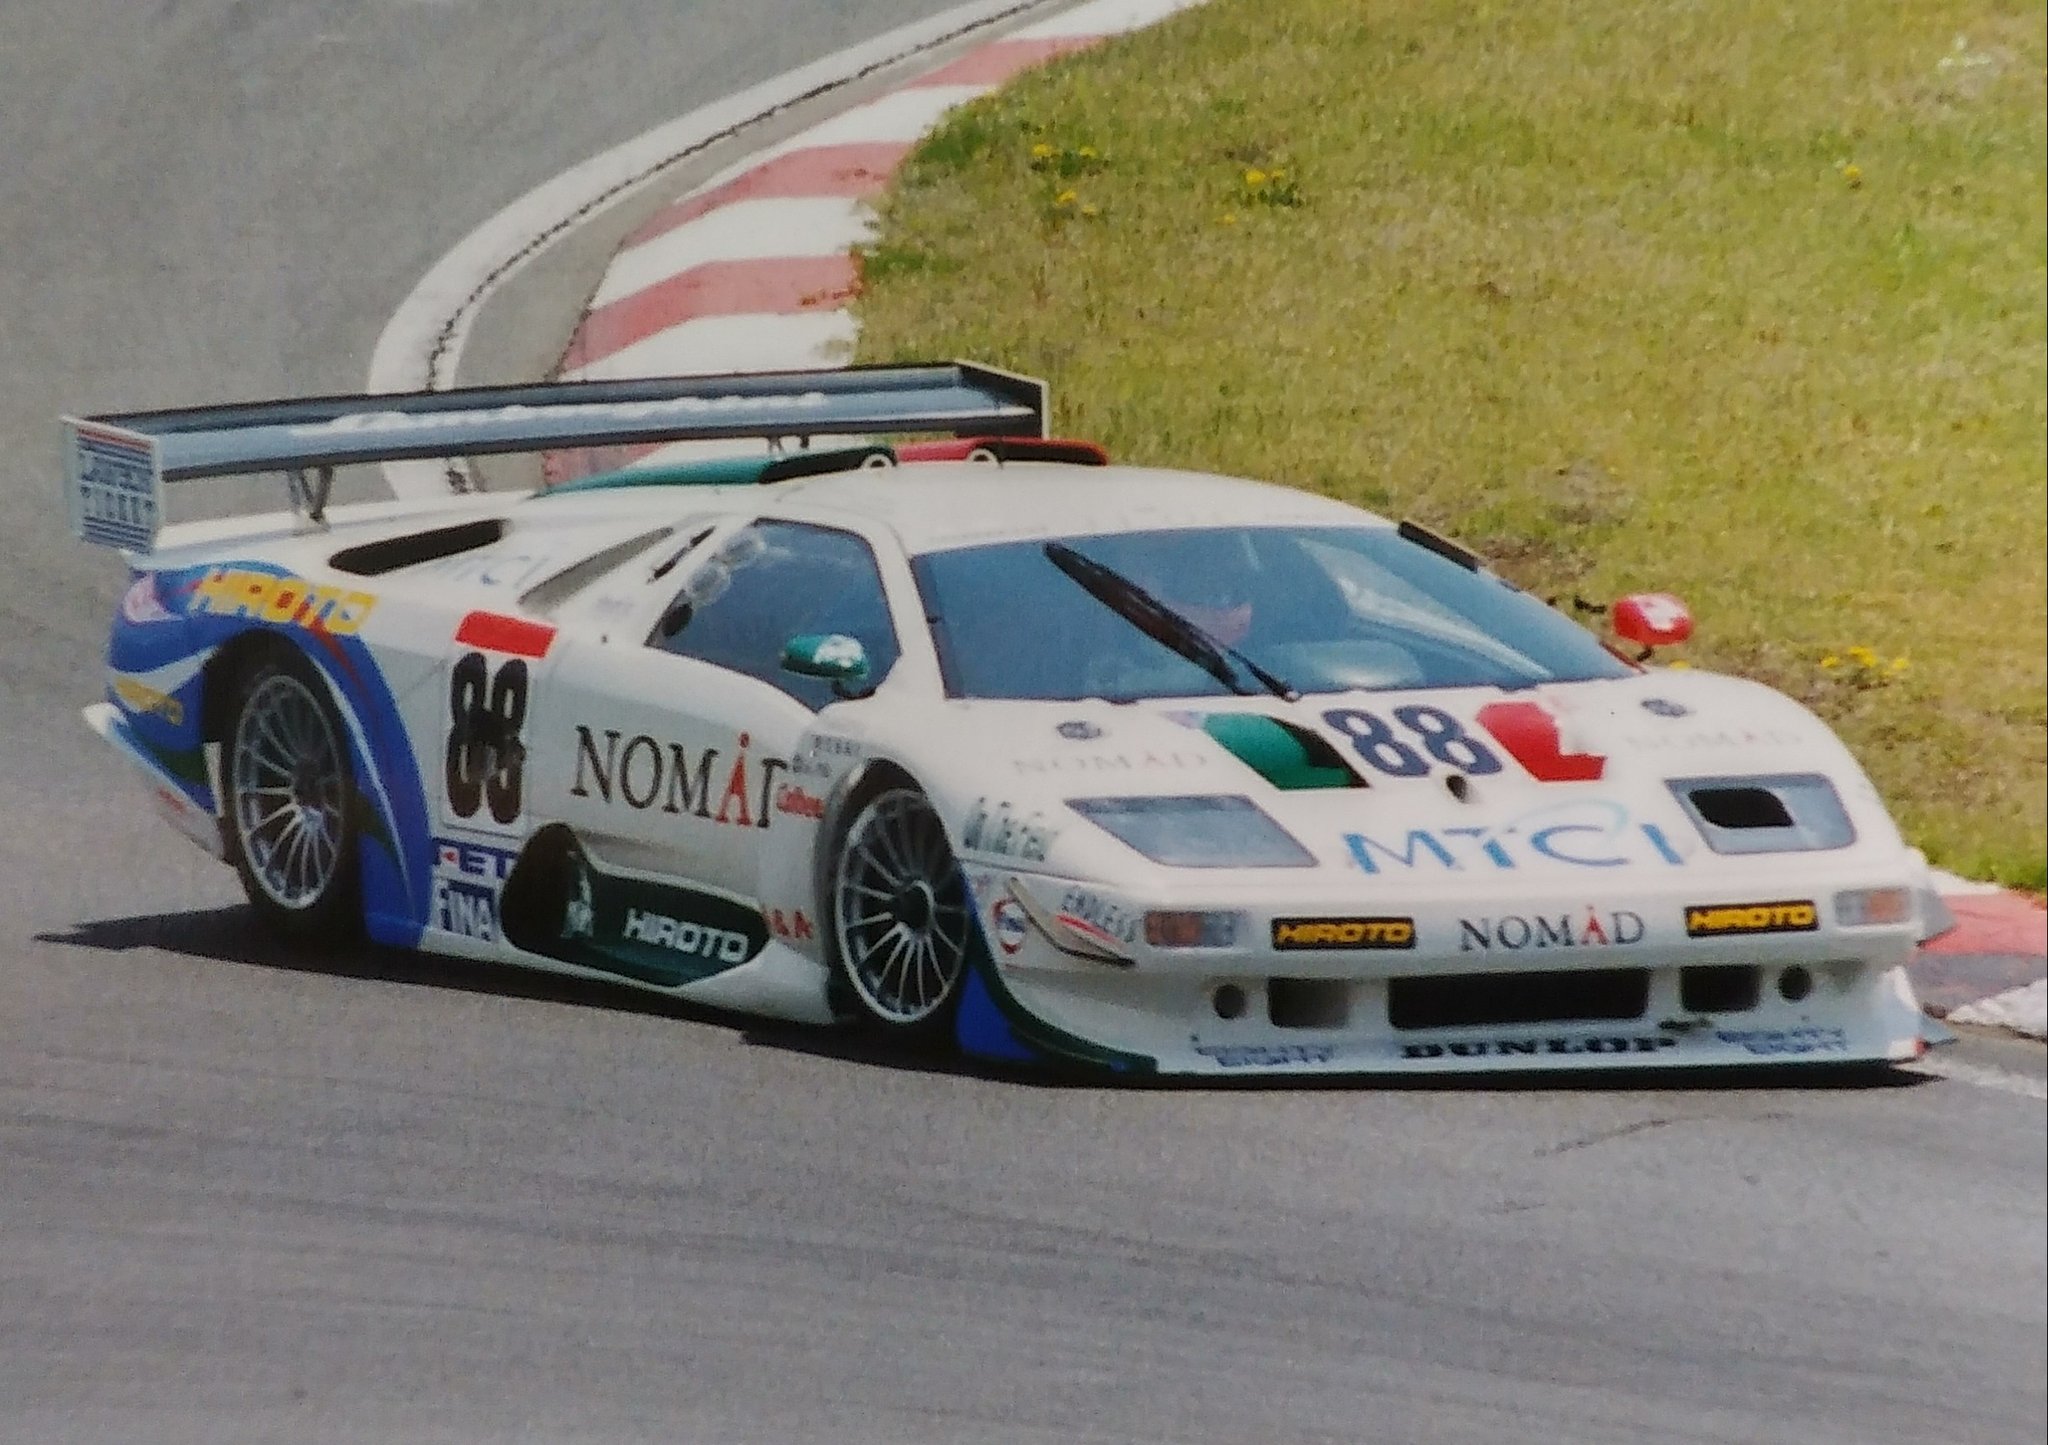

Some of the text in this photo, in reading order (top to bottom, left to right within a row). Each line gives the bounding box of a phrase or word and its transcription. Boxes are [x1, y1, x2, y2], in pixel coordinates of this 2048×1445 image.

[187, 570, 378, 635] HIROTO
[447, 651, 528, 825] 88
[1322, 704, 1503, 777] 88
[1342, 822, 1686, 876] MTCI
[623, 907, 750, 964] HIROTO
[1273, 919, 1414, 947] HIROTO
[1686, 903, 1813, 933] HIROTO
[1400, 1036, 1678, 1060] DUNLOP
